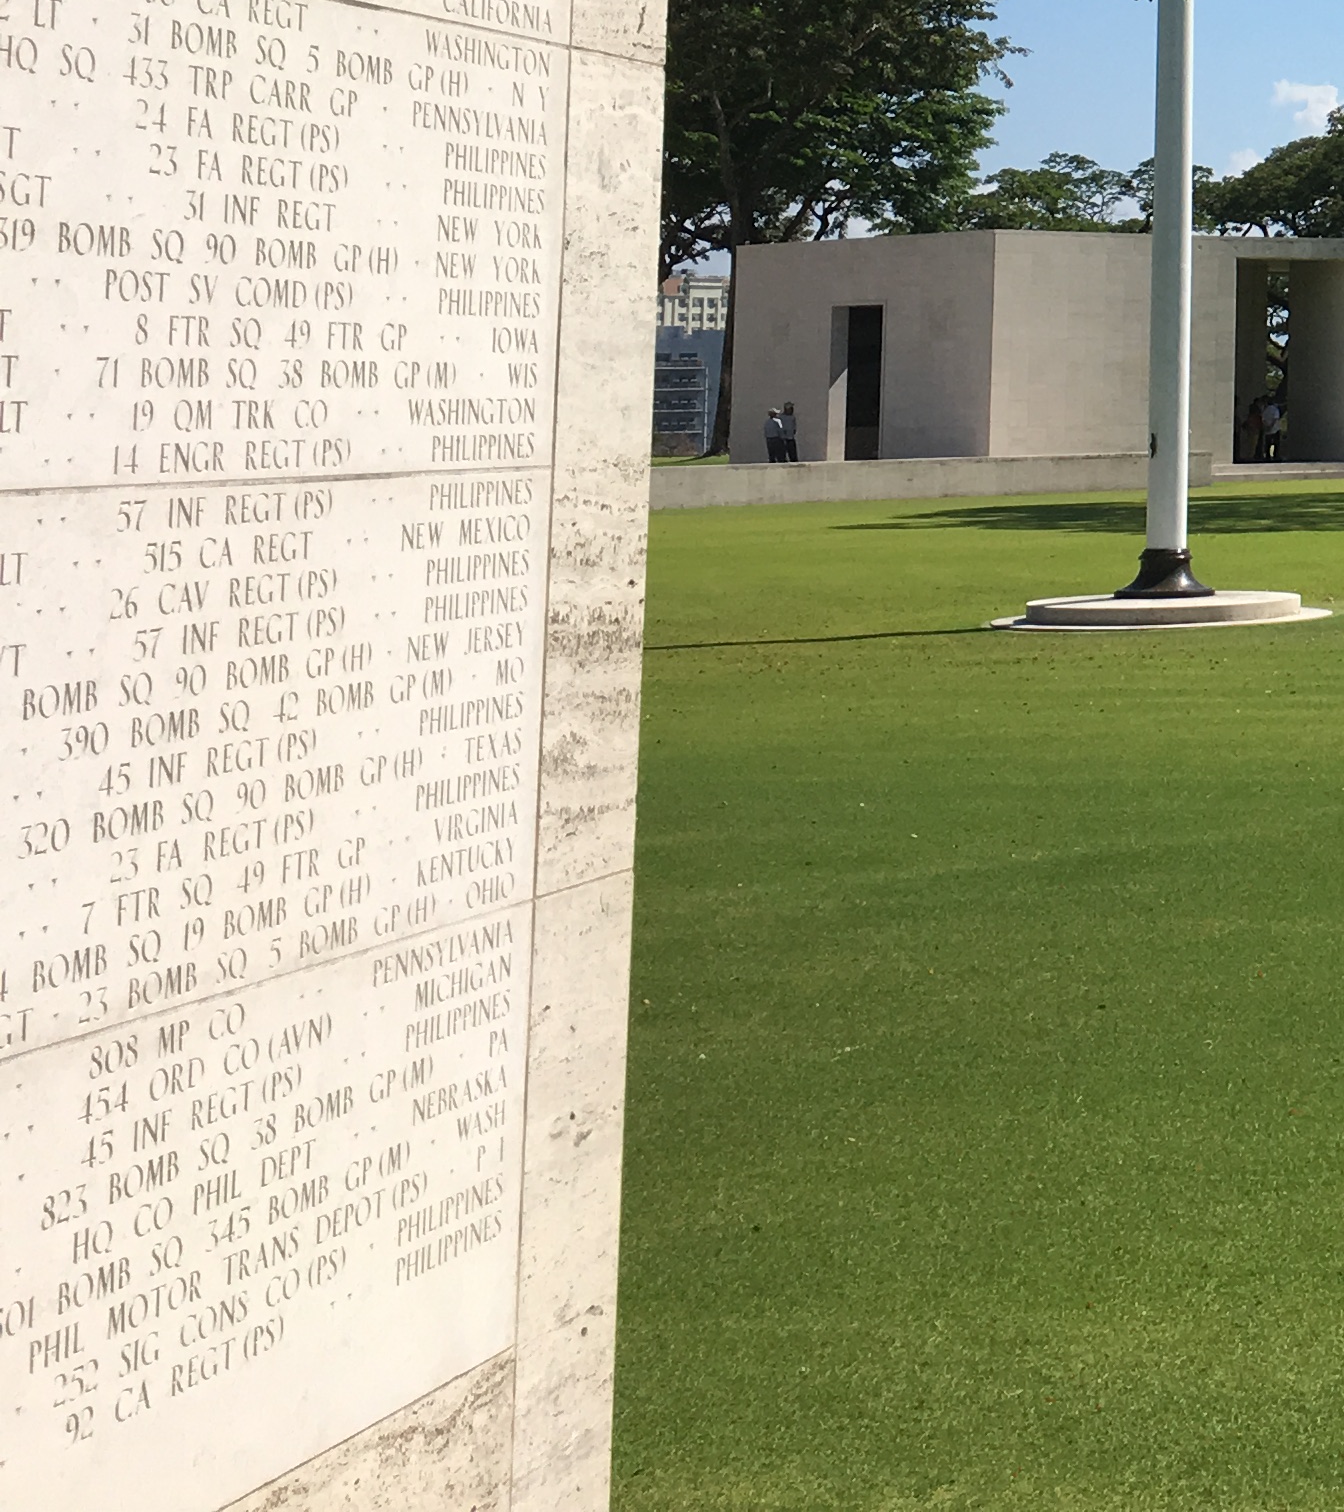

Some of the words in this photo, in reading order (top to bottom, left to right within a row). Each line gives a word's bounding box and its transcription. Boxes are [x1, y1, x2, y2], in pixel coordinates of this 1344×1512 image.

[58, 42, 97, 84] SQ
[121, 54, 170, 90] 433
[187, 63, 234, 101] TRP
[248, 72, 313, 114] CARR
[328, 86, 359, 119] GP
[411, 99, 548, 147] PENNSYLVANIA
[424, 27, 551, 78] WASHINGTON
[185, 188, 205, 223] 31
[222, 192, 261, 227] INF
[276, 197, 337, 233] REGT
[436, 213, 479, 245] NEW
[493, 218, 543, 250] YORK
[133, 311, 149, 347] 8
[167, 313, 211, 348] FTR
[228, 315, 263, 352] SQ
[282, 318, 312, 350] 49
[326, 320, 364, 352] FTR
[377, 320, 408, 353] GP
[491, 325, 539, 355] IOWA
[131, 398, 155, 432] 19
[172, 397, 213, 434] QM
[230, 398, 275, 431] TRK
[293, 398, 329, 430] CO
[407, 396, 536, 427] WASHINGTON
[143, 538, 183, 573] 515
[198, 535, 234, 570] CA
[252, 529, 314, 566] REGT
[400, 520, 445, 553] NEW
[457, 512, 531, 547] MEXICO
[80, 899, 97, 936] 7
[113, 885, 161, 928] FTR
[180, 872, 214, 907] SQ
[235, 859, 266, 895] 49
[280, 847, 321, 887] FTR
[336, 835, 366, 870] GP
[433, 798, 519, 845] VIRGINIA
[76, 1079, 129, 1126] 454
[148, 1055, 206, 1103] ORD
[413, 951, 512, 1013] MICHIGAN
[87, 1032, 139, 1081] 808
[156, 1018, 191, 1059] MP
[207, 1001, 246, 1042] CO
[371, 918, 514, 989] PENNSYLVANIA
[39, 1182, 88, 1232] 823
[107, 1149, 180, 1206] BOMB
[196, 1130, 231, 1173] SQ
[252, 1111, 277, 1147] 38
[292, 1084, 354, 1134] BOMB
[487, 1026, 509, 1059] PA
[71, 1219, 114, 1266] HQ
[132, 1195, 174, 1239] CO
[192, 1167, 243, 1217] PHIL
[259, 1137, 317, 1189] DEPT
[411, 1063, 508, 1127] NEBRASKA
